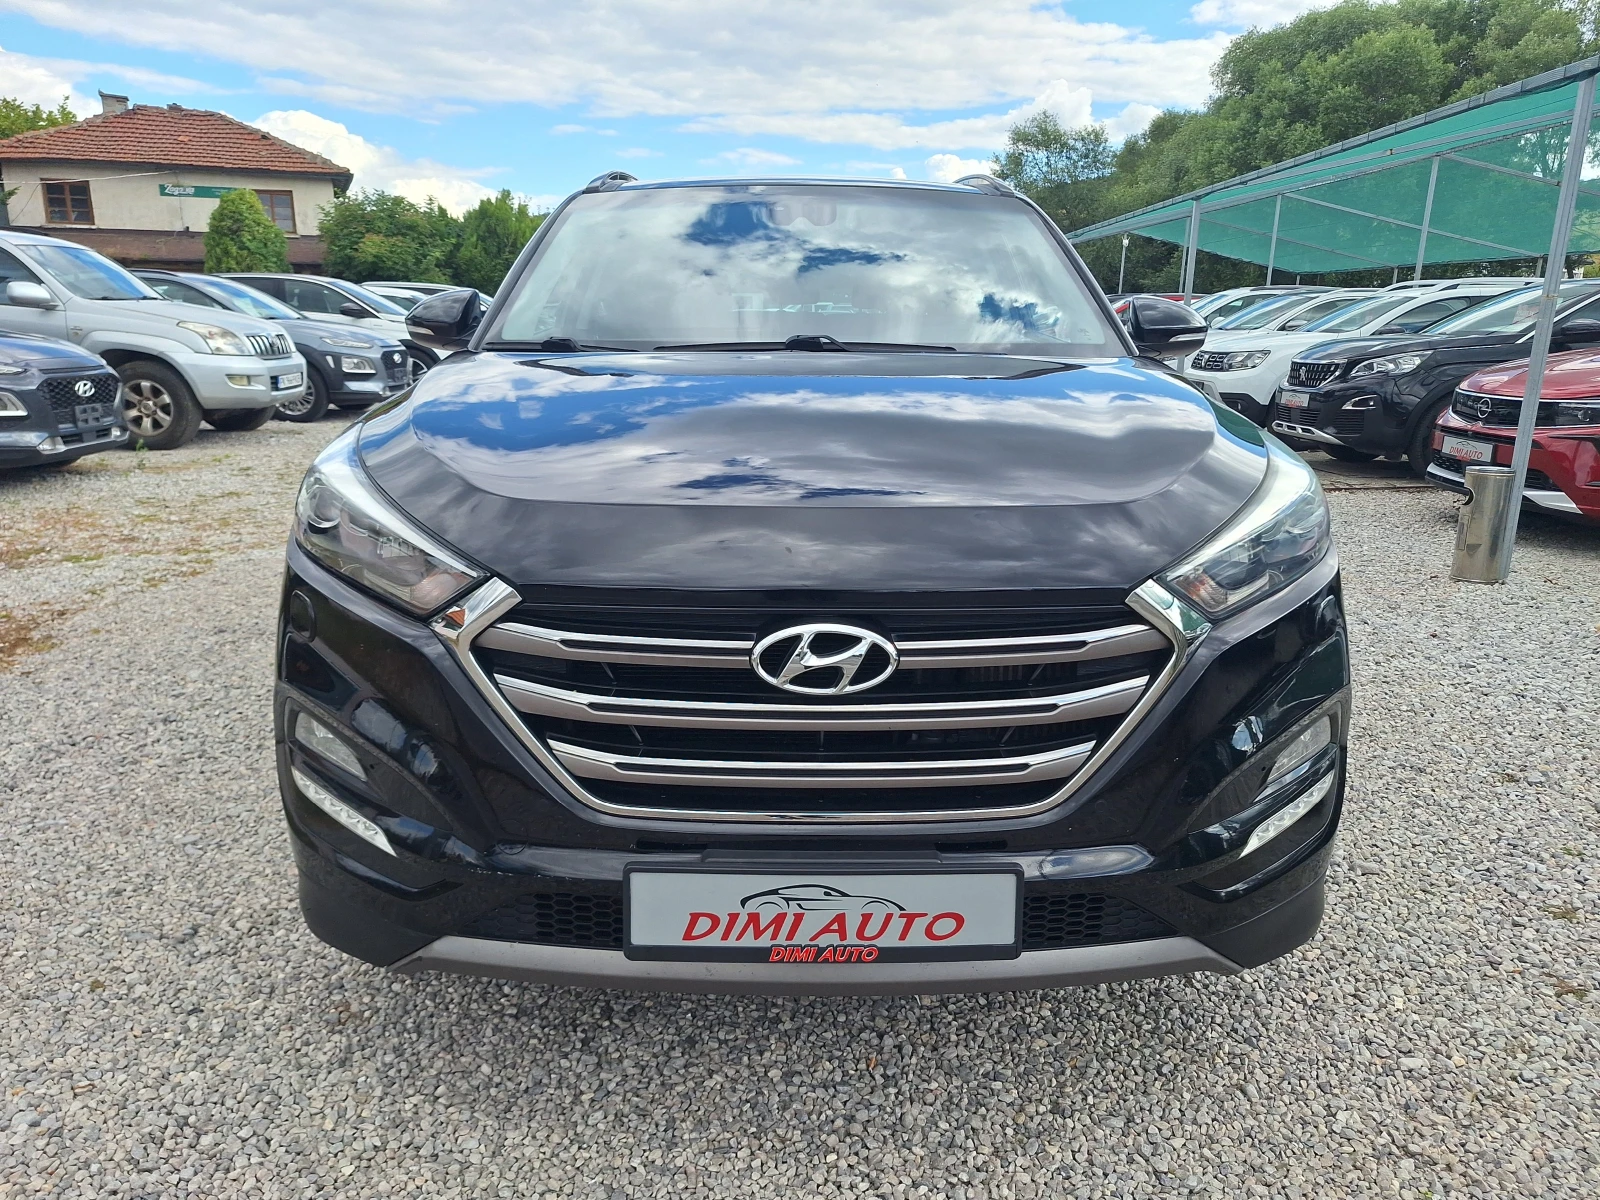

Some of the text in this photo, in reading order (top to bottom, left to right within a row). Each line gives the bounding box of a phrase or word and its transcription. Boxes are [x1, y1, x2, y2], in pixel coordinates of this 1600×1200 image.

[1449, 446, 1464, 455] DIMI
[1463, 449, 1483, 459] AUTO
[682, 912, 966, 941] DIMI AUTO
[769, 946, 879, 962] DIMI AUTO
